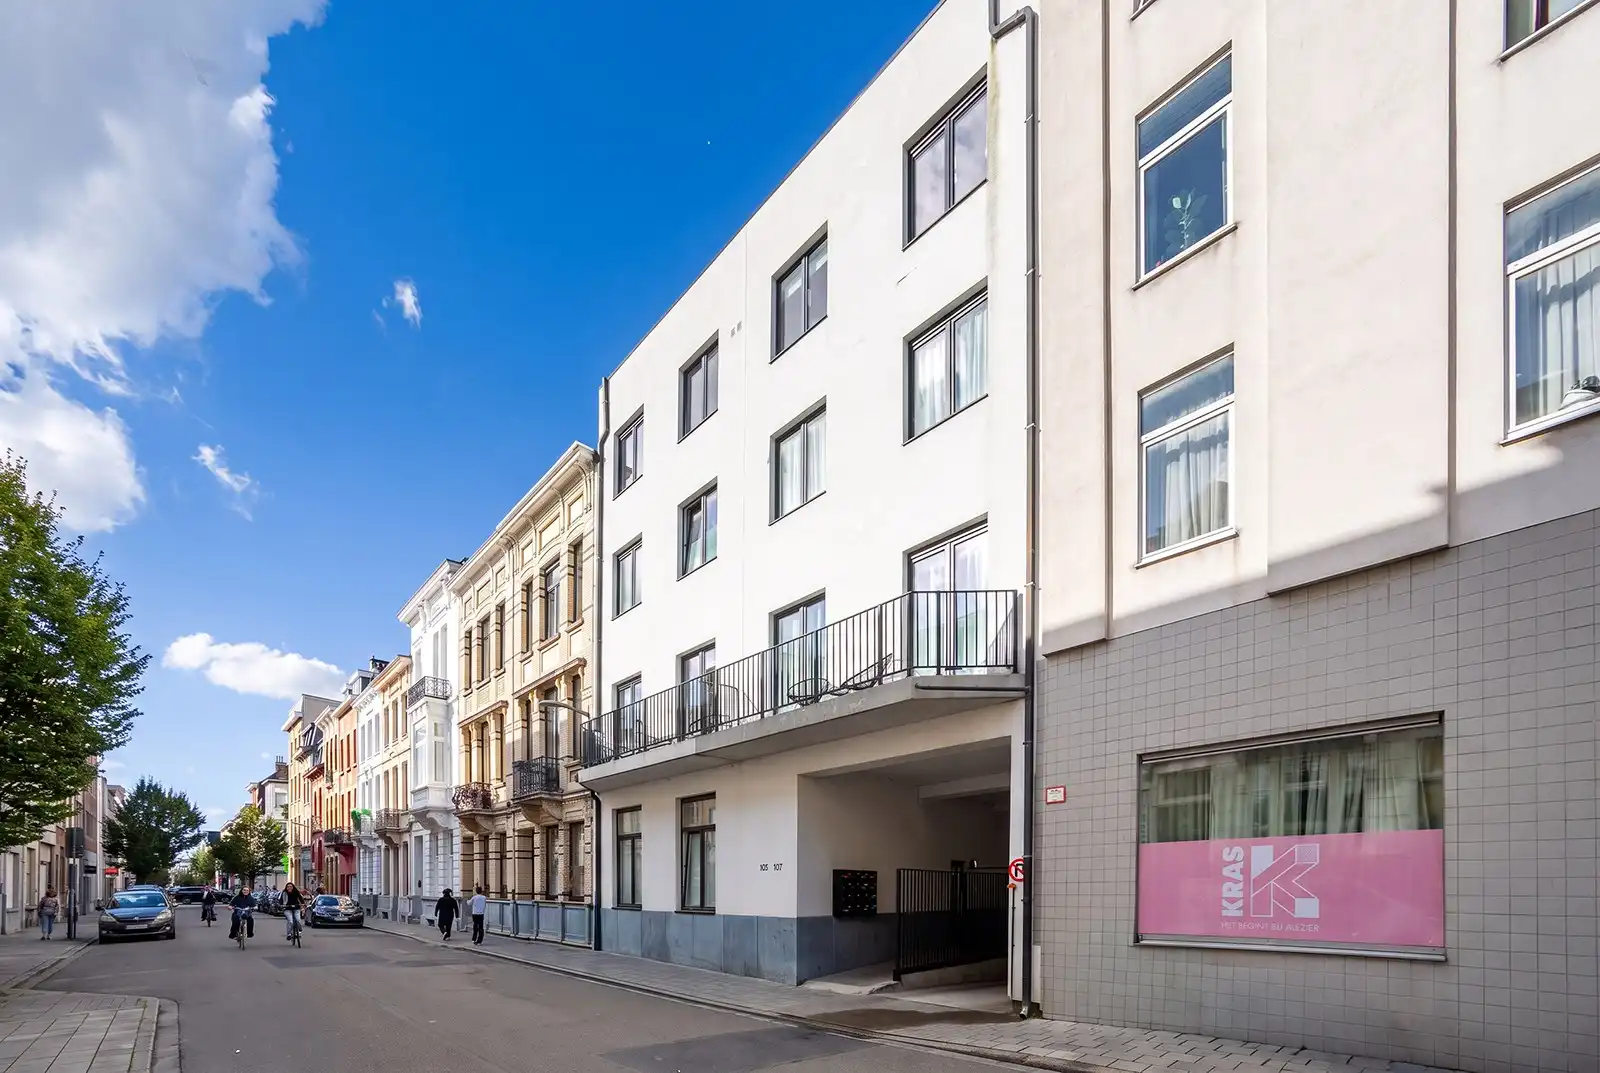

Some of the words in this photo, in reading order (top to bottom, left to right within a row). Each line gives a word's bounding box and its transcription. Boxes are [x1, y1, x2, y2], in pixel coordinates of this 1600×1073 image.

[759, 863, 769, 872] 105
[773, 863, 783, 872] 107
[1222, 846, 1244, 917] KRAS
[1221, 922, 1236, 930] HET
[1238, 922, 1269, 931] BEGINT
